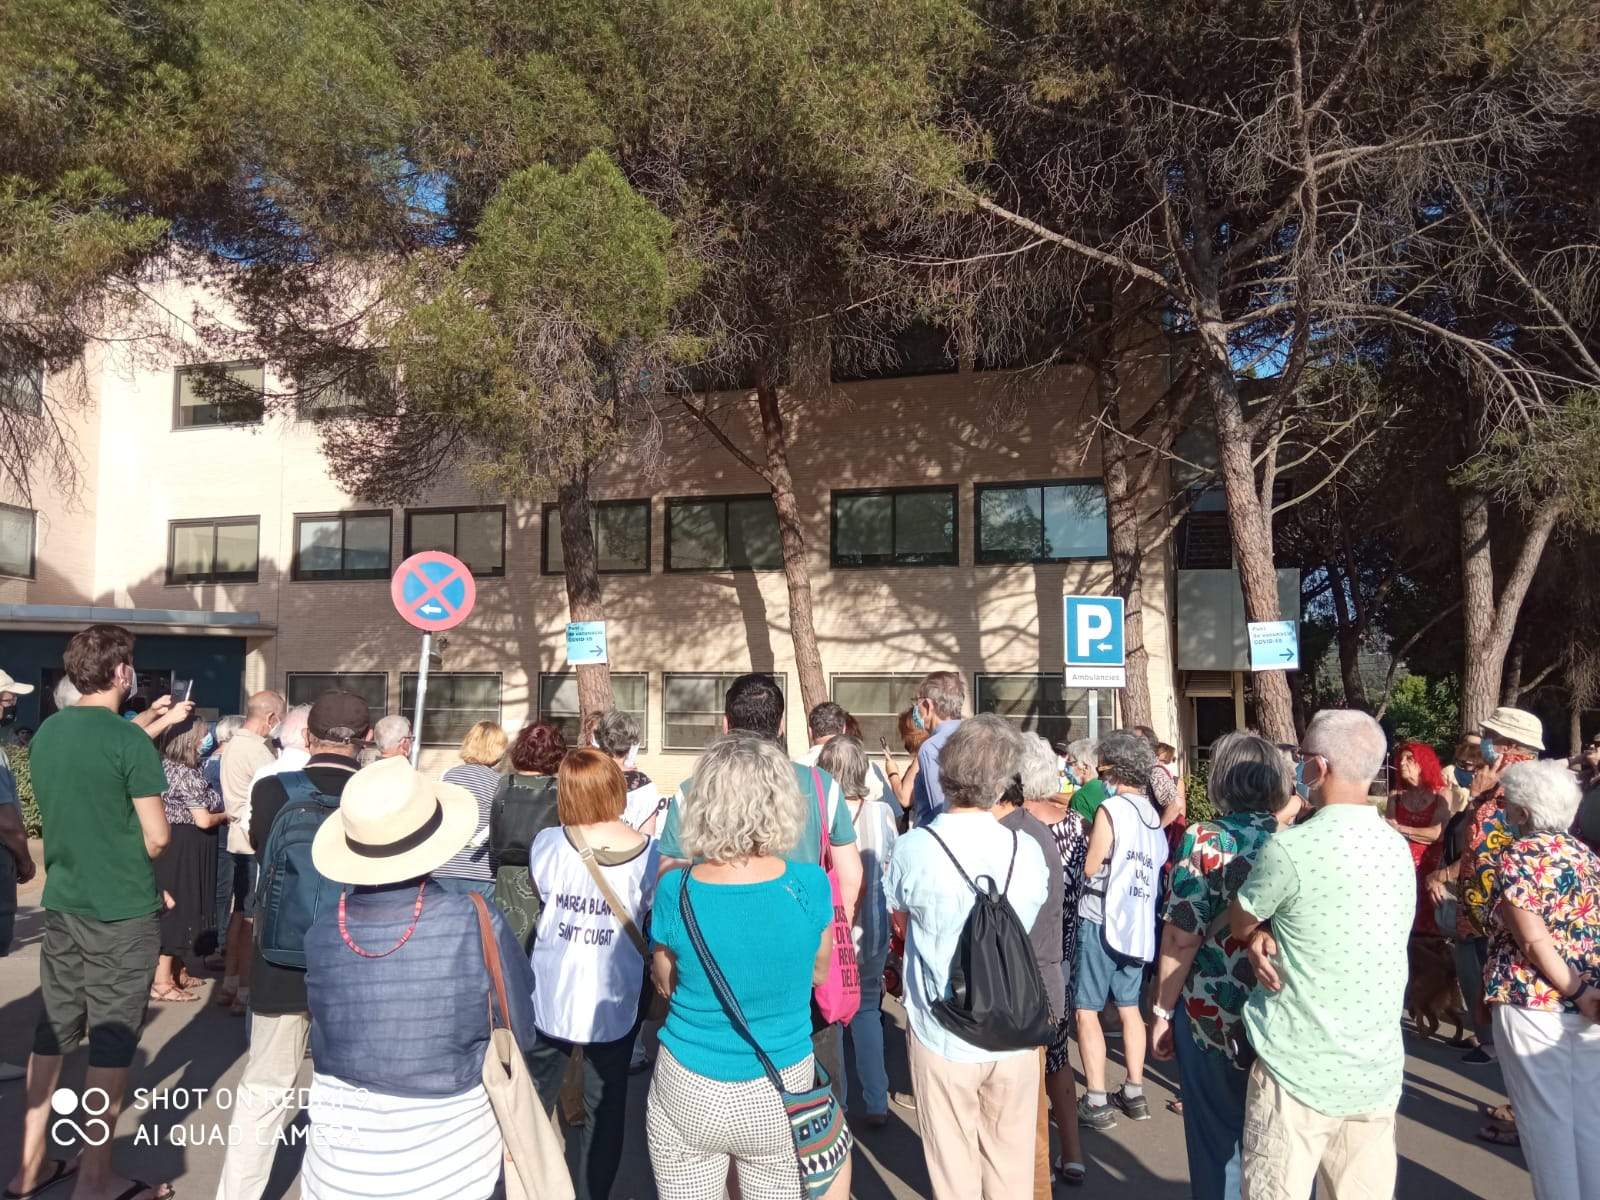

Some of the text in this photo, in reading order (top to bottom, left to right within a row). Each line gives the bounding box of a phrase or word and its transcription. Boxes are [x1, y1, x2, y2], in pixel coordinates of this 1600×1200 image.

[1077, 604, 1112, 656] P
[556, 893, 587, 915] MAREA
[584, 928, 615, 946] CUGAT
